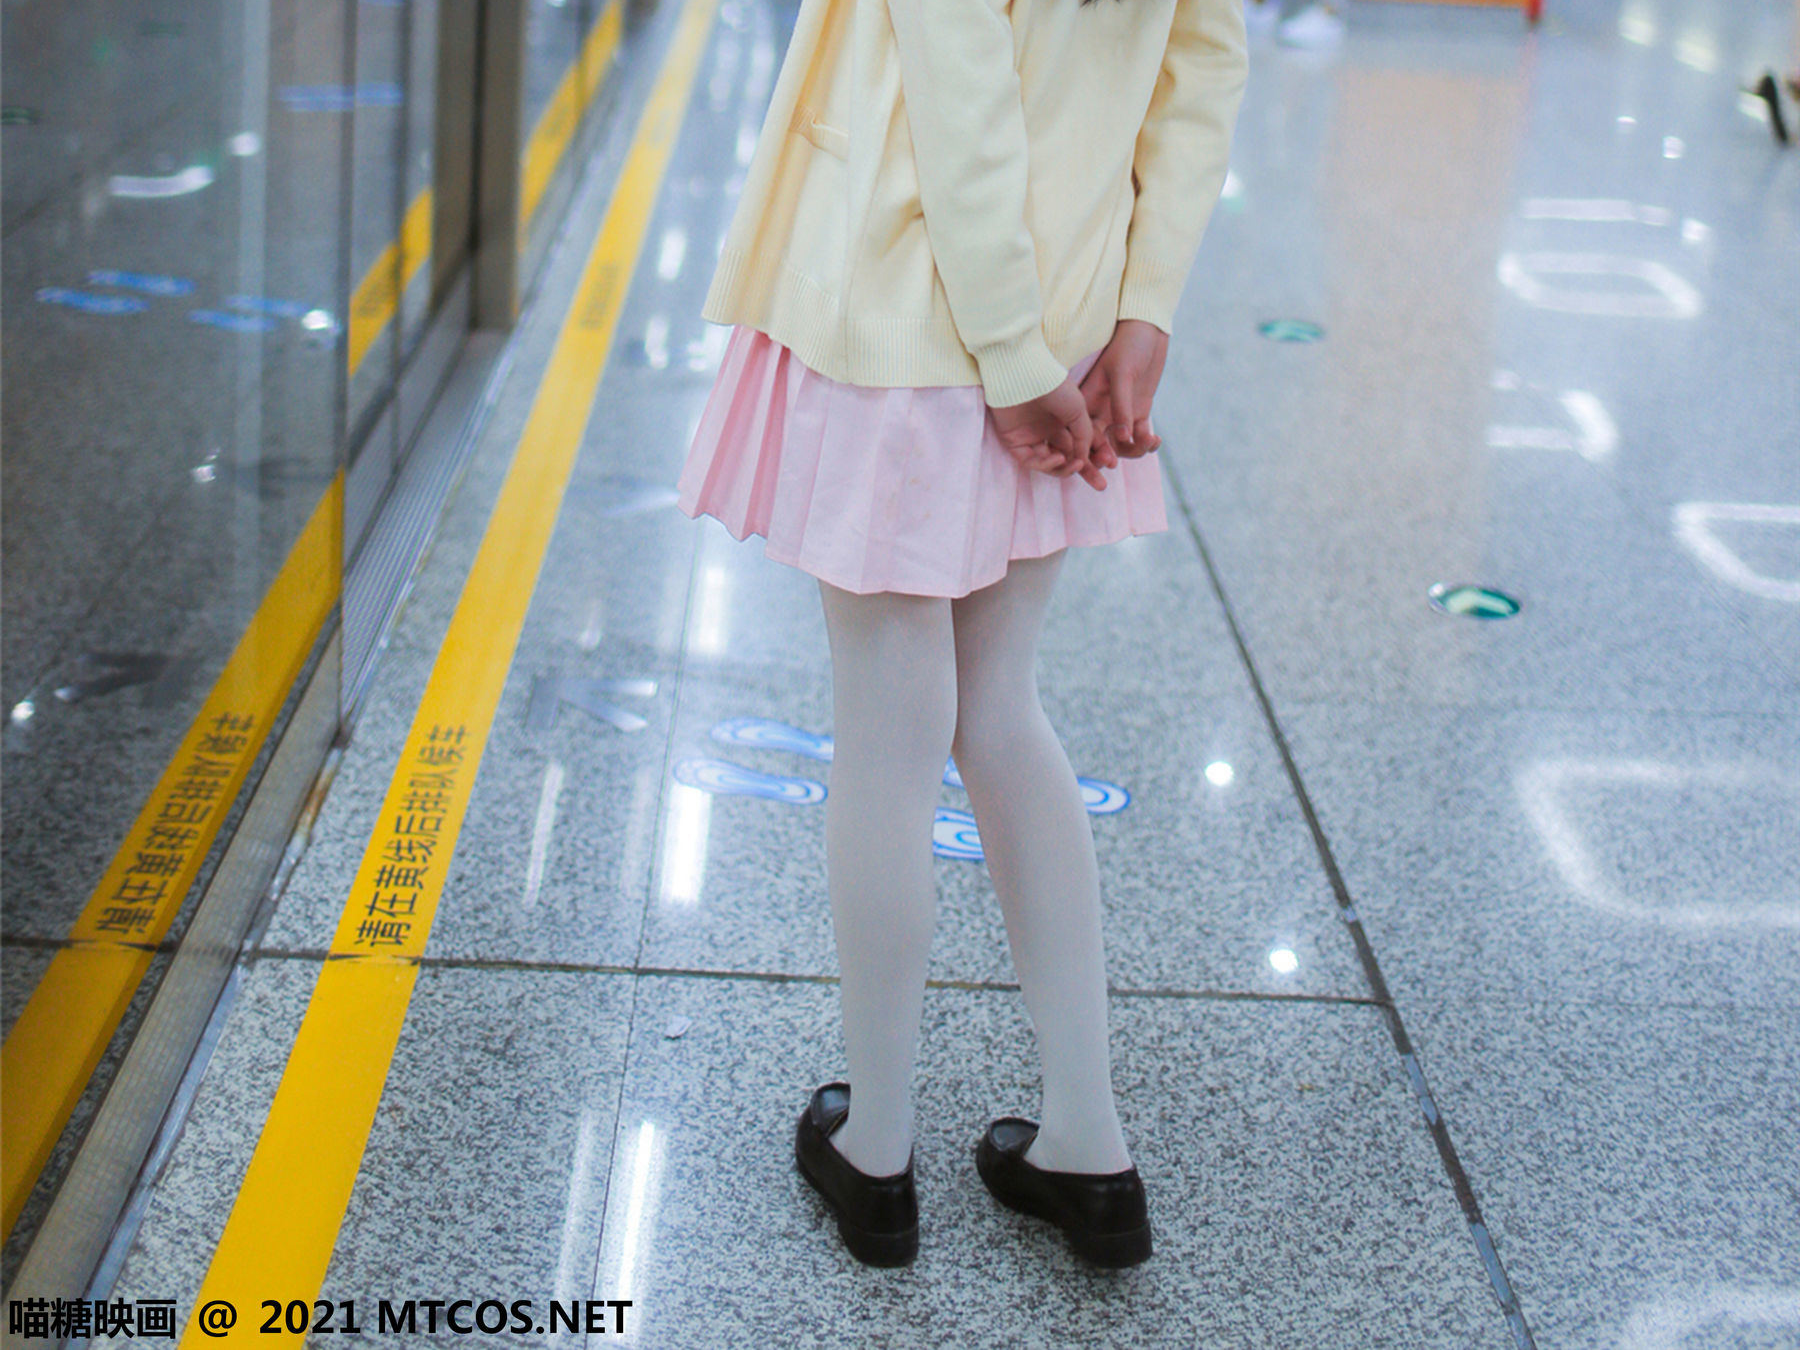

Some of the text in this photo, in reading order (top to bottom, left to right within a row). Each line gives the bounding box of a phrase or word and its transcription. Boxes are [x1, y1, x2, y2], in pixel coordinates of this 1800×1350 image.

[354, 724, 468, 947] 请在黄线后排队候车
